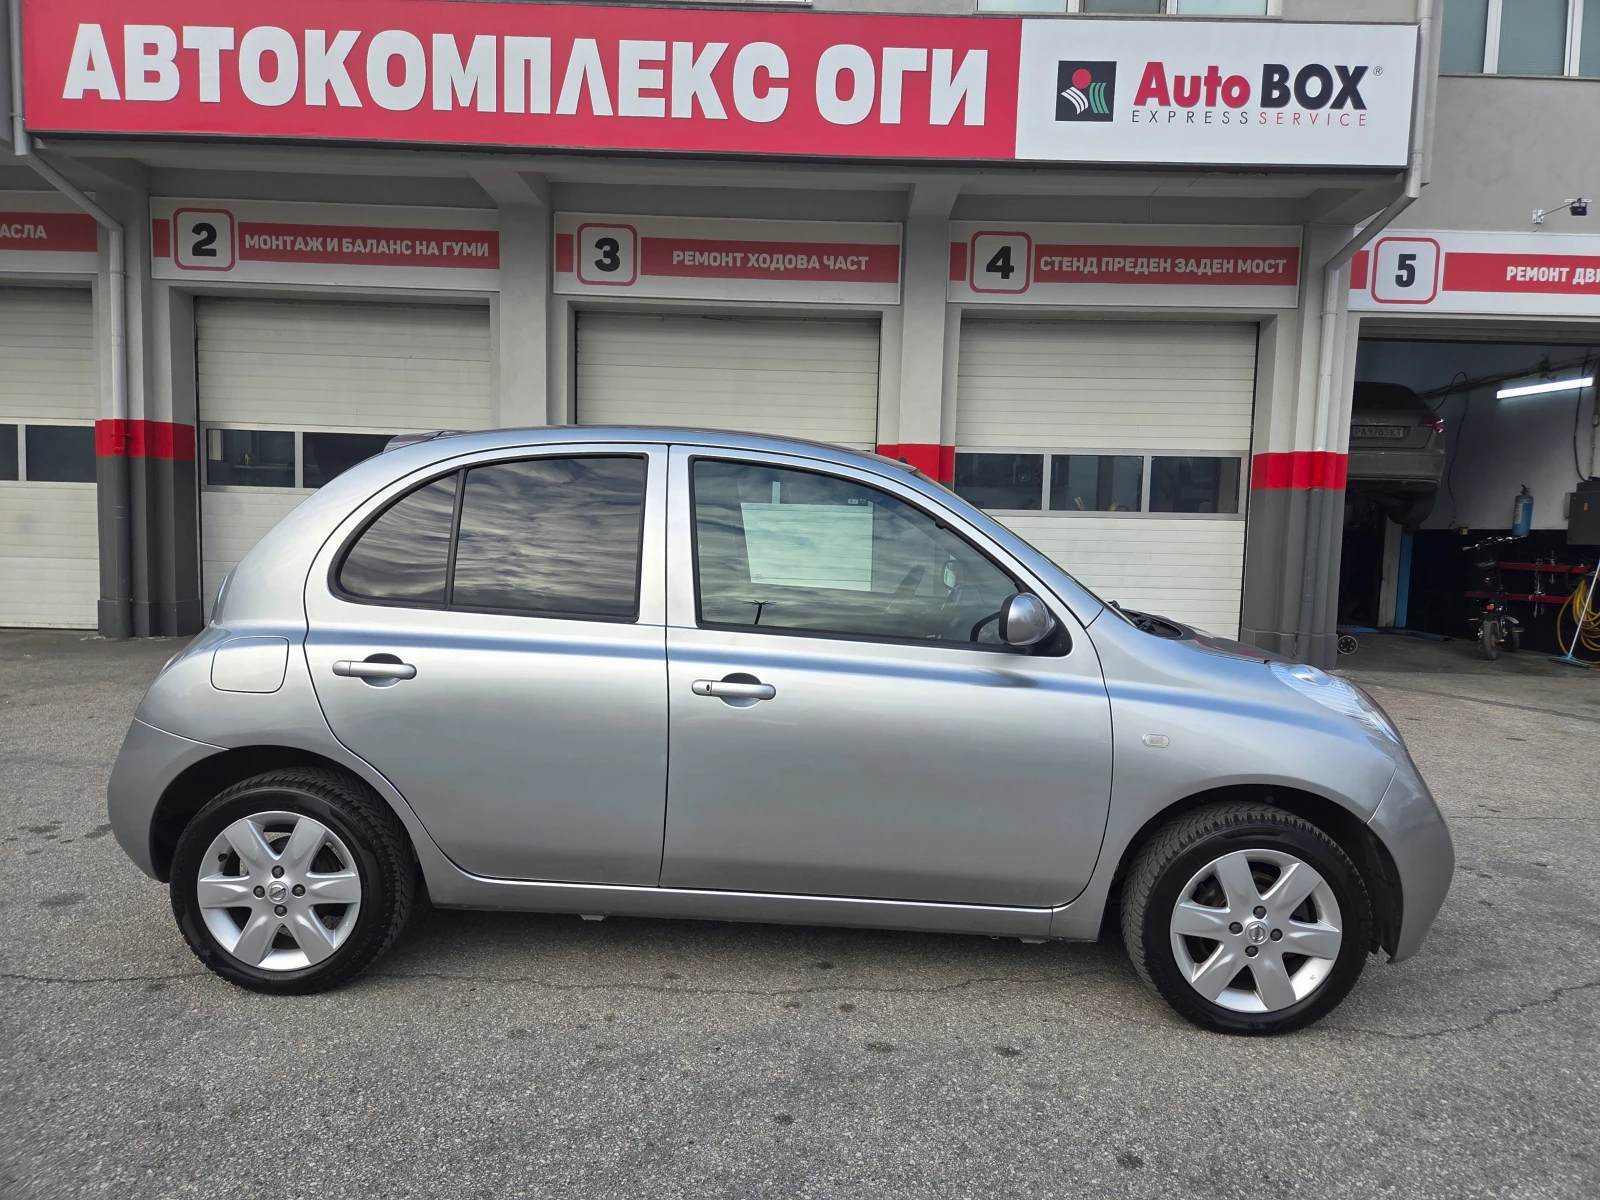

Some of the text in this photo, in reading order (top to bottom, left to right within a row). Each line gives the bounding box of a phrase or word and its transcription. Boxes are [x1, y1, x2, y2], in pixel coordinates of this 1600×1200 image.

[62, 23, 989, 126] АВТОКОМПЛЕКС ОГИ
[1133, 61, 1251, 109] Auto
[1132, 110, 1367, 127] EXPRESS SERVICE
[191, 222, 218, 257] 2
[245, 234, 489, 257] МОНТАЖ И БАЛАНС НА ГУМИ
[593, 237, 621, 272] 3
[673, 250, 869, 271] РЕМОНТ ХОДОВА ЧАСТ
[985, 245, 1015, 280] 4
[1040, 256, 1287, 276] СТЕНД ПРЕДЕН ЗАДЕН МОСТ
[1395, 253, 1417, 288] 5
[1506, 266, 1570, 282] РЕМОНТ
